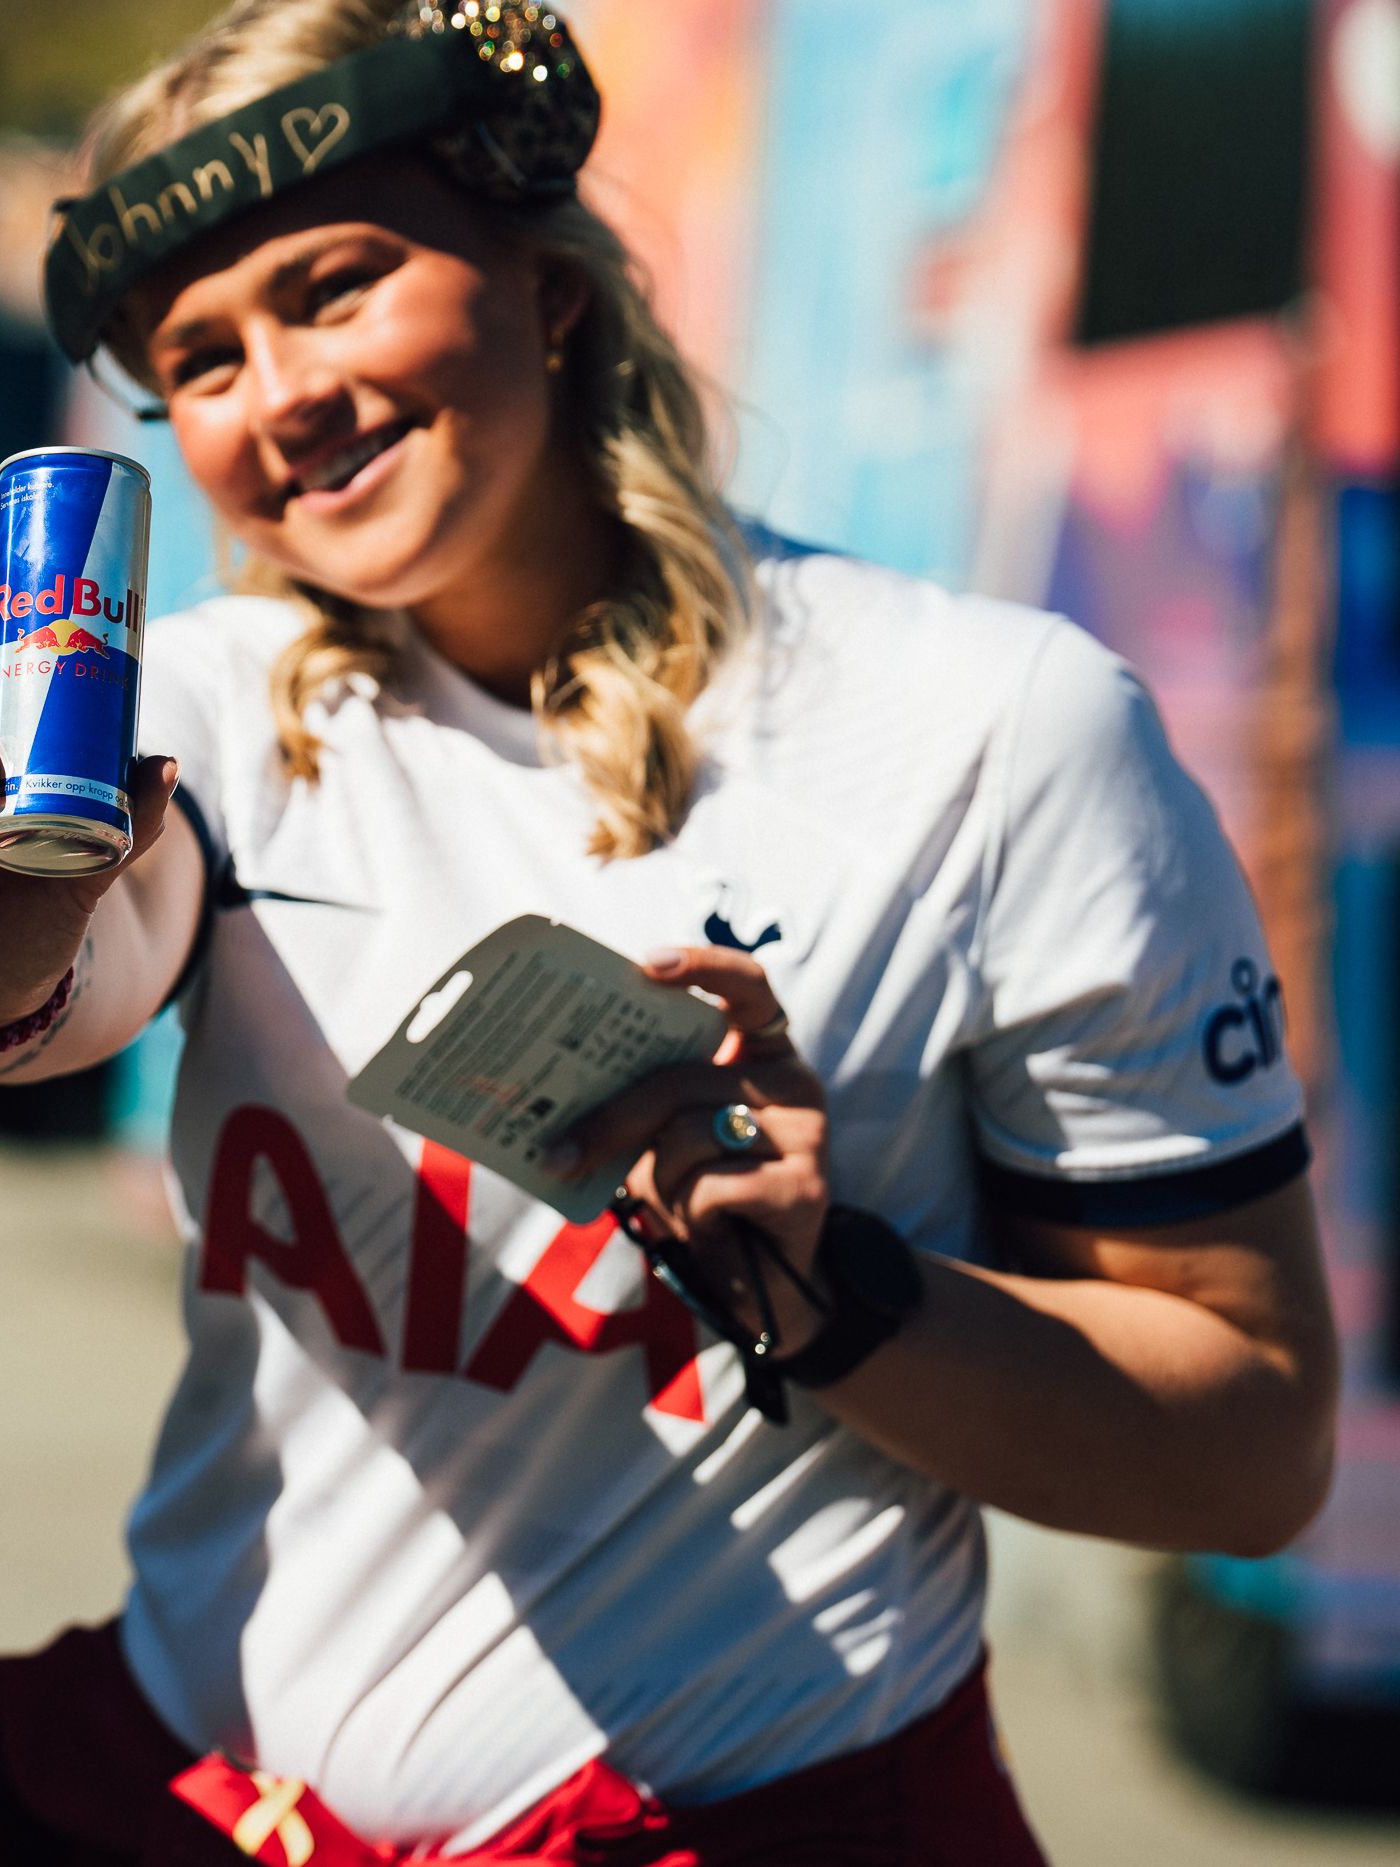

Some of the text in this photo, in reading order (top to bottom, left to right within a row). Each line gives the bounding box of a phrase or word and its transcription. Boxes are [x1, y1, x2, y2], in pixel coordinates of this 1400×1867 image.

[66, 130, 274, 296] Johnny
[72, 577, 139, 633] Bull
[25, 778, 62, 789] Kvikker
[65, 782, 86, 793] opp
[88, 782, 114, 801] kropp
[199, 1103, 707, 1424] AIA
